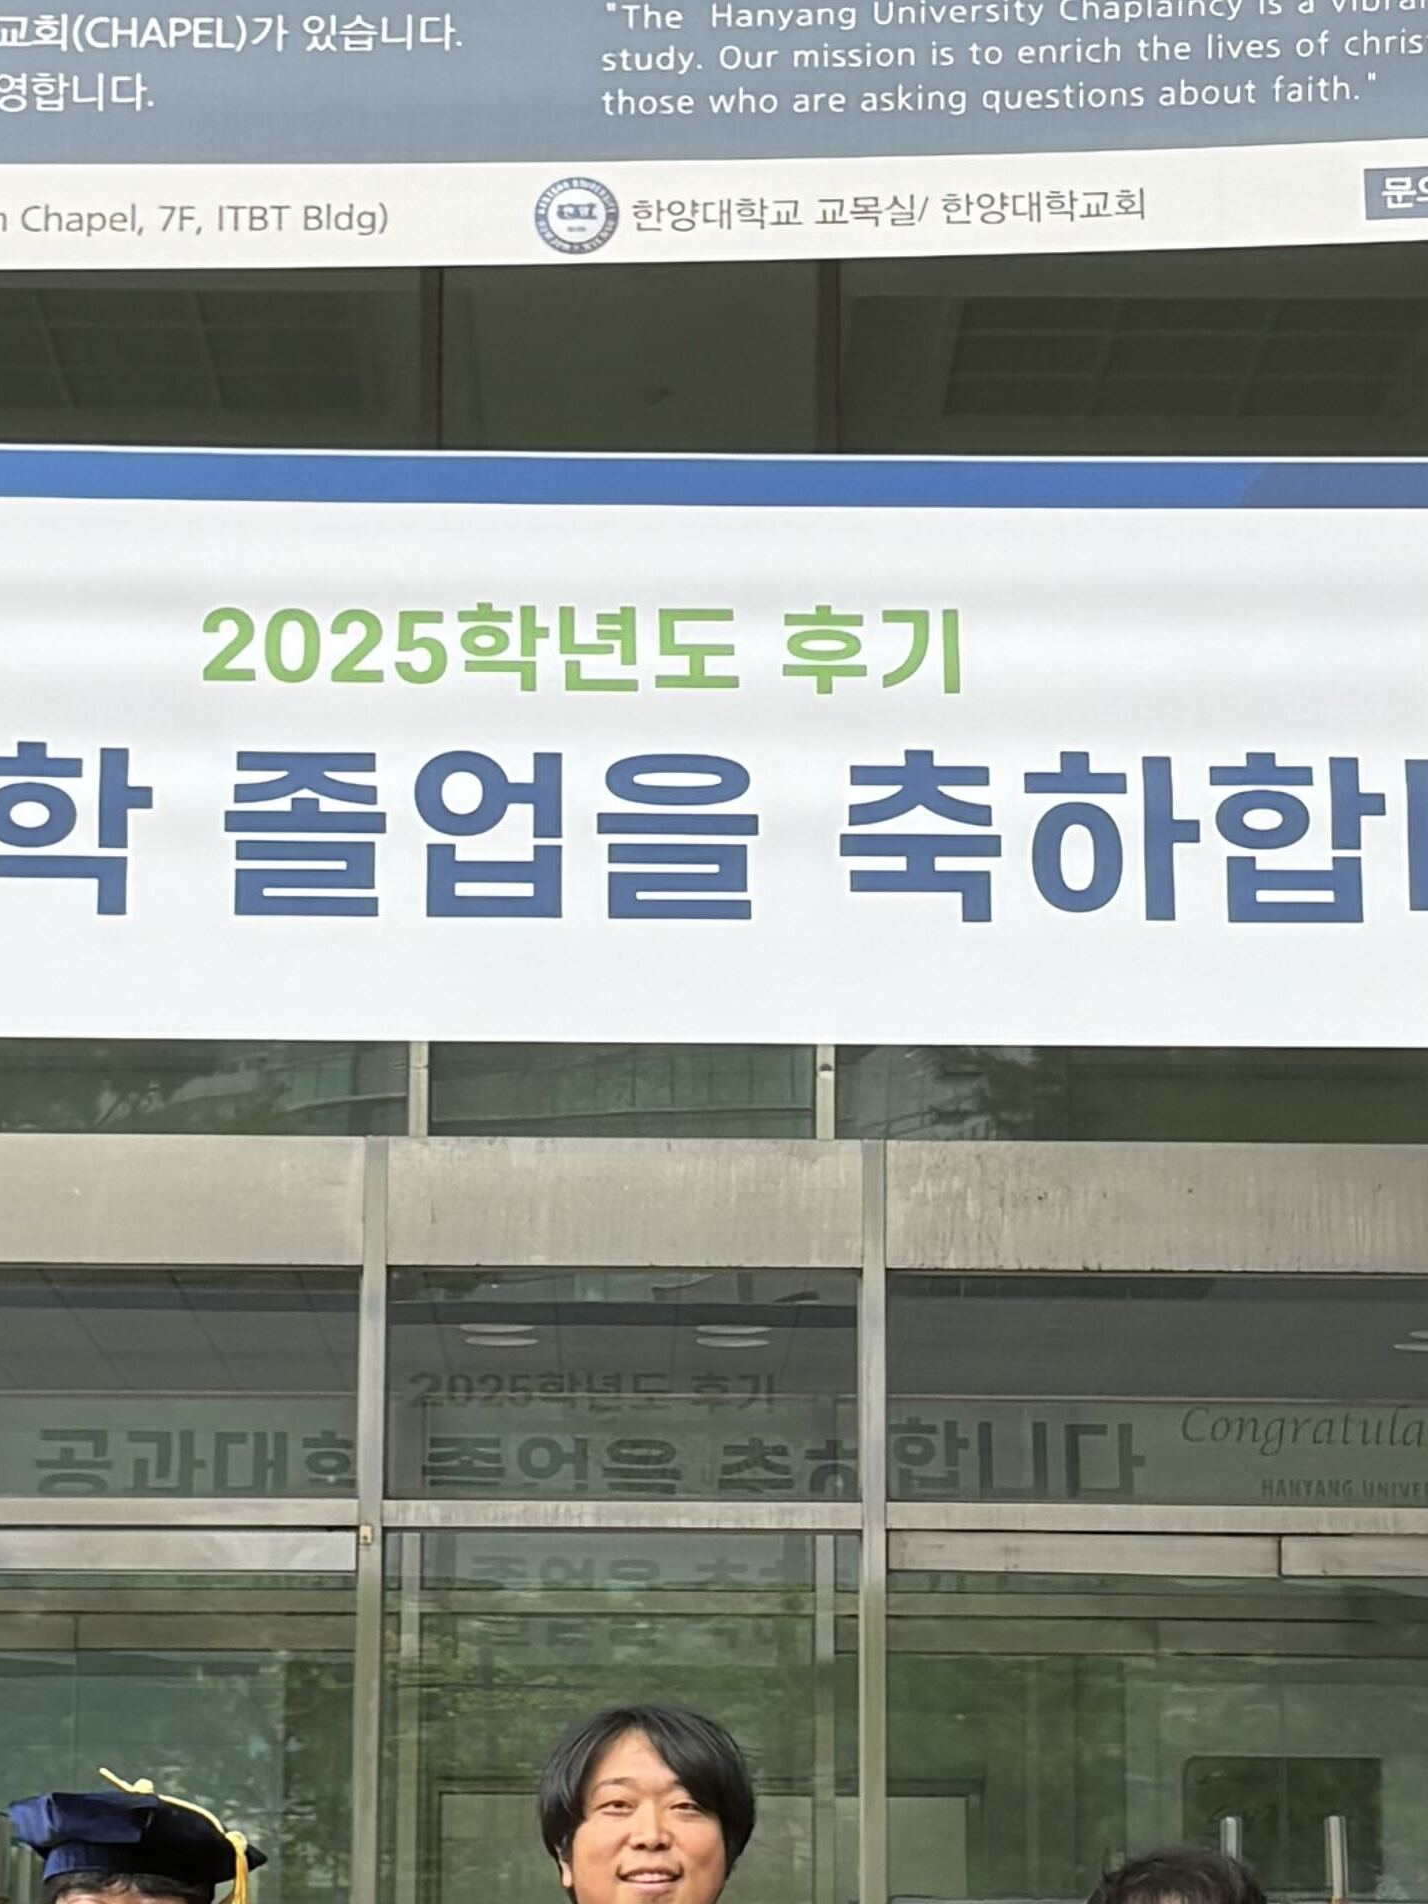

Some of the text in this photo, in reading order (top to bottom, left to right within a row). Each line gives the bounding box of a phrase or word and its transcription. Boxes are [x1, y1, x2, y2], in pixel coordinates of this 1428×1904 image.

[302, 13, 463, 52] 있습니다.
[606, 2, 684, 29] "The
[711, 3, 857, 31] Hanyang
[601, 44, 703, 75] study.
[719, 45, 779, 70] Our
[793, 42, 916, 68] mission
[931, 40, 955, 66] is
[968, 42, 1003, 66] to
[1017, 36, 1121, 64] enrich
[1137, 34, 1192, 62] the
[1207, 33, 1281, 60] lives
[1295, 29, 1329, 58] of
[601, 71, 1376, 116] those who are asking questions about faith."
[20, 203, 144, 238] Chapel,
[158, 205, 203, 236] 7F,
[216, 199, 287, 236] ITBT
[303, 202, 388, 237] Bldg)
[631, 197, 804, 233] 한양대학교
[814, 193, 930, 228] 교목실/
[941, 187, 1145, 225] 한양대학교회
[202, 601, 961, 695] 2025학년도 후기
[223, 750, 760, 921] 졸업을
